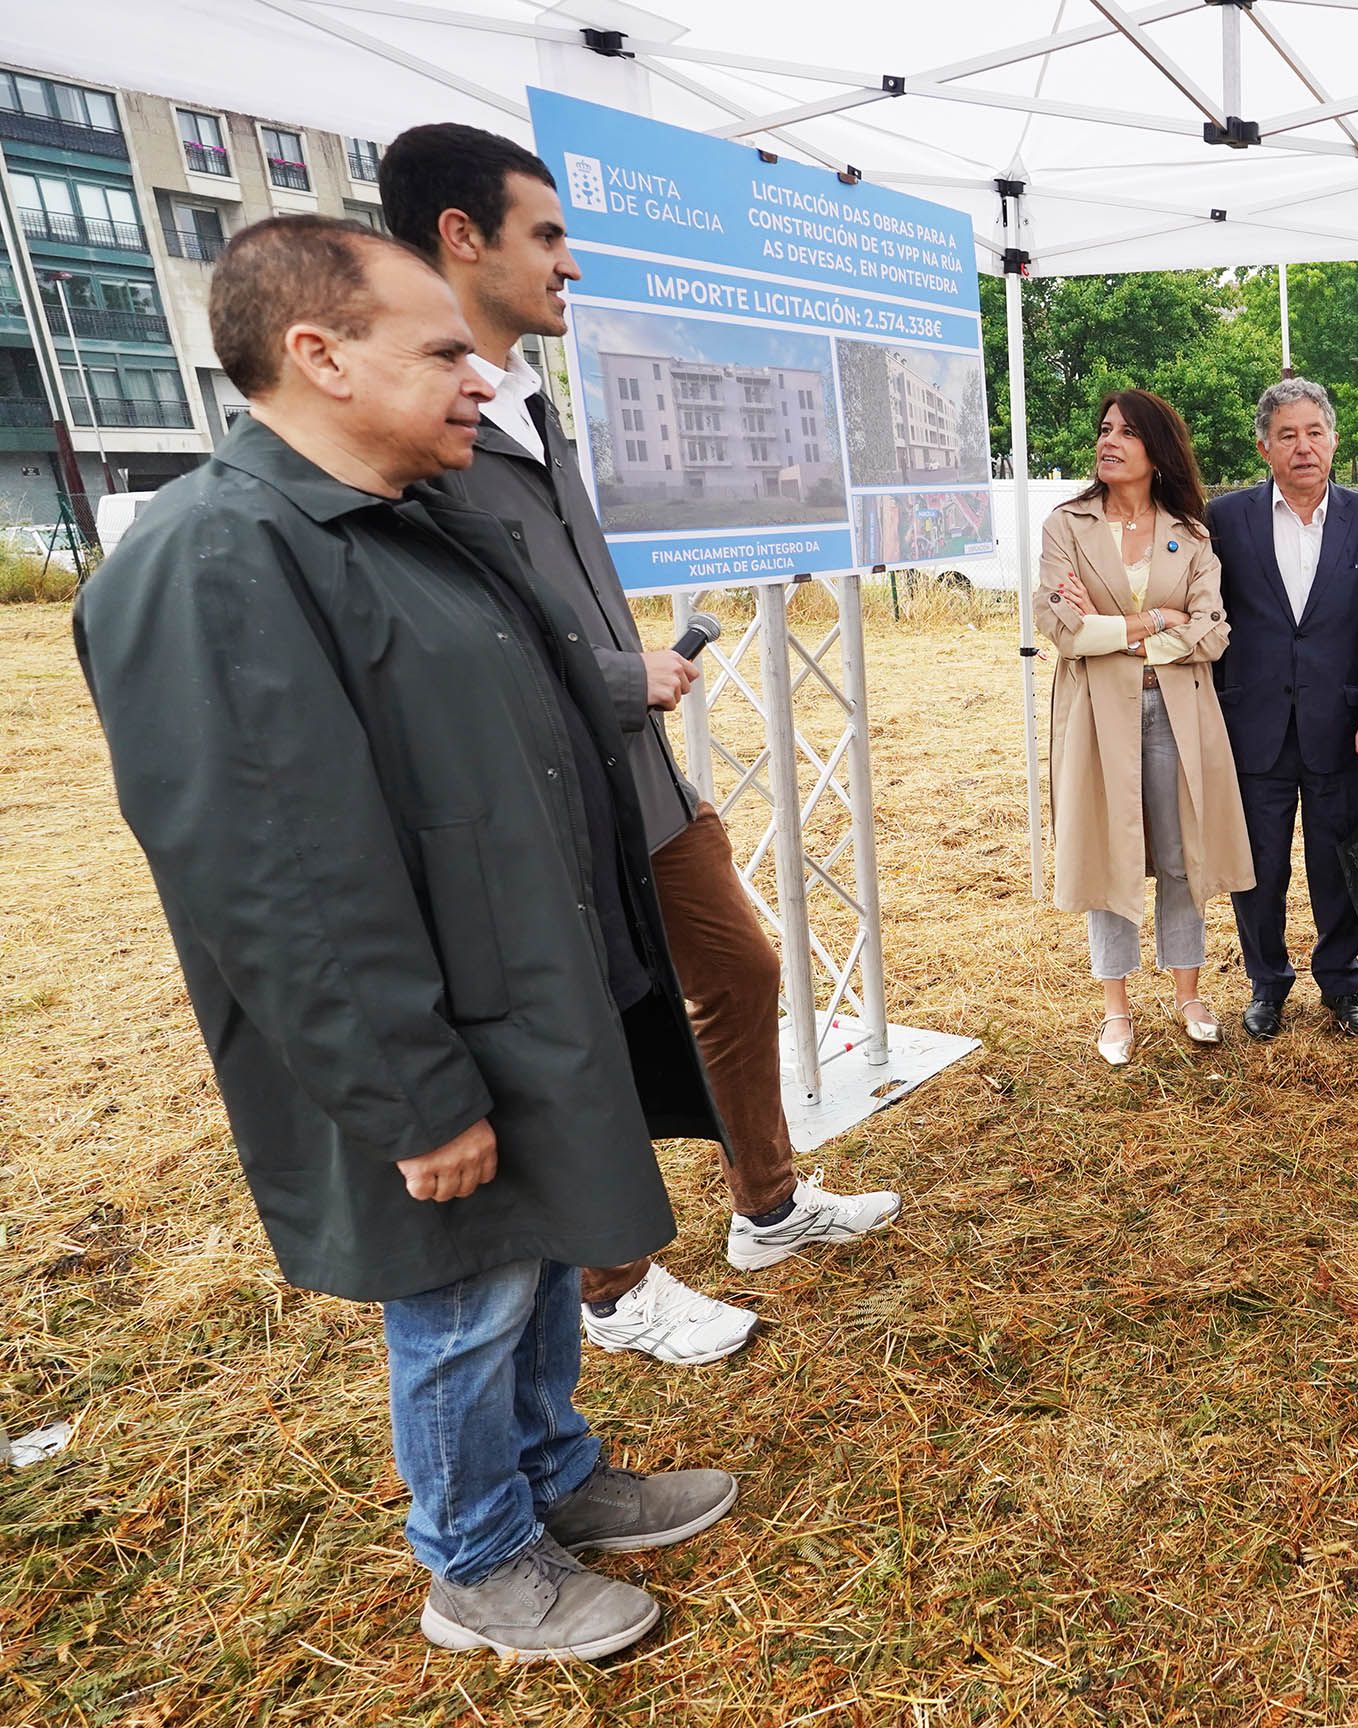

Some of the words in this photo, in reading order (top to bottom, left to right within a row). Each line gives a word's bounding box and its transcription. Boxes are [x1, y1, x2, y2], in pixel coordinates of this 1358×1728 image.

[607, 164, 681, 200] XUNTA
[610, 191, 639, 216] DE
[645, 199, 725, 234] GALICIA
[752, 180, 839, 218] LICITACIÓN
[843, 207, 870, 227] DAS
[873, 215, 914, 237] OBRAS
[917, 224, 946, 245] PARA
[949, 233, 957, 249] A
[748, 207, 858, 249] CONSTRUCIÓN
[861, 235, 878, 254] DE
[881, 240, 895, 258] 13
[896, 243, 919, 263] VPP
[922, 249, 938, 268] NA
[941, 252, 963, 273] RÚA
[763, 239, 783, 260] AS
[788, 244, 857, 276] DEVESAS,
[860, 260, 877, 278] EN
[880, 263, 958, 295] PONTEVEDRA
[646, 272, 750, 311] IMPORTE
[754, 290, 861, 326] LICITACIÓN:
[864, 308, 943, 339] 2.574.338€
[651, 545, 754, 563] FINANCIAMENTO
[806, 541, 821, 553] DA
[689, 562, 731, 577] XUNTA
[734, 560, 748, 572] DE
[751, 557, 795, 572] GALICIA
